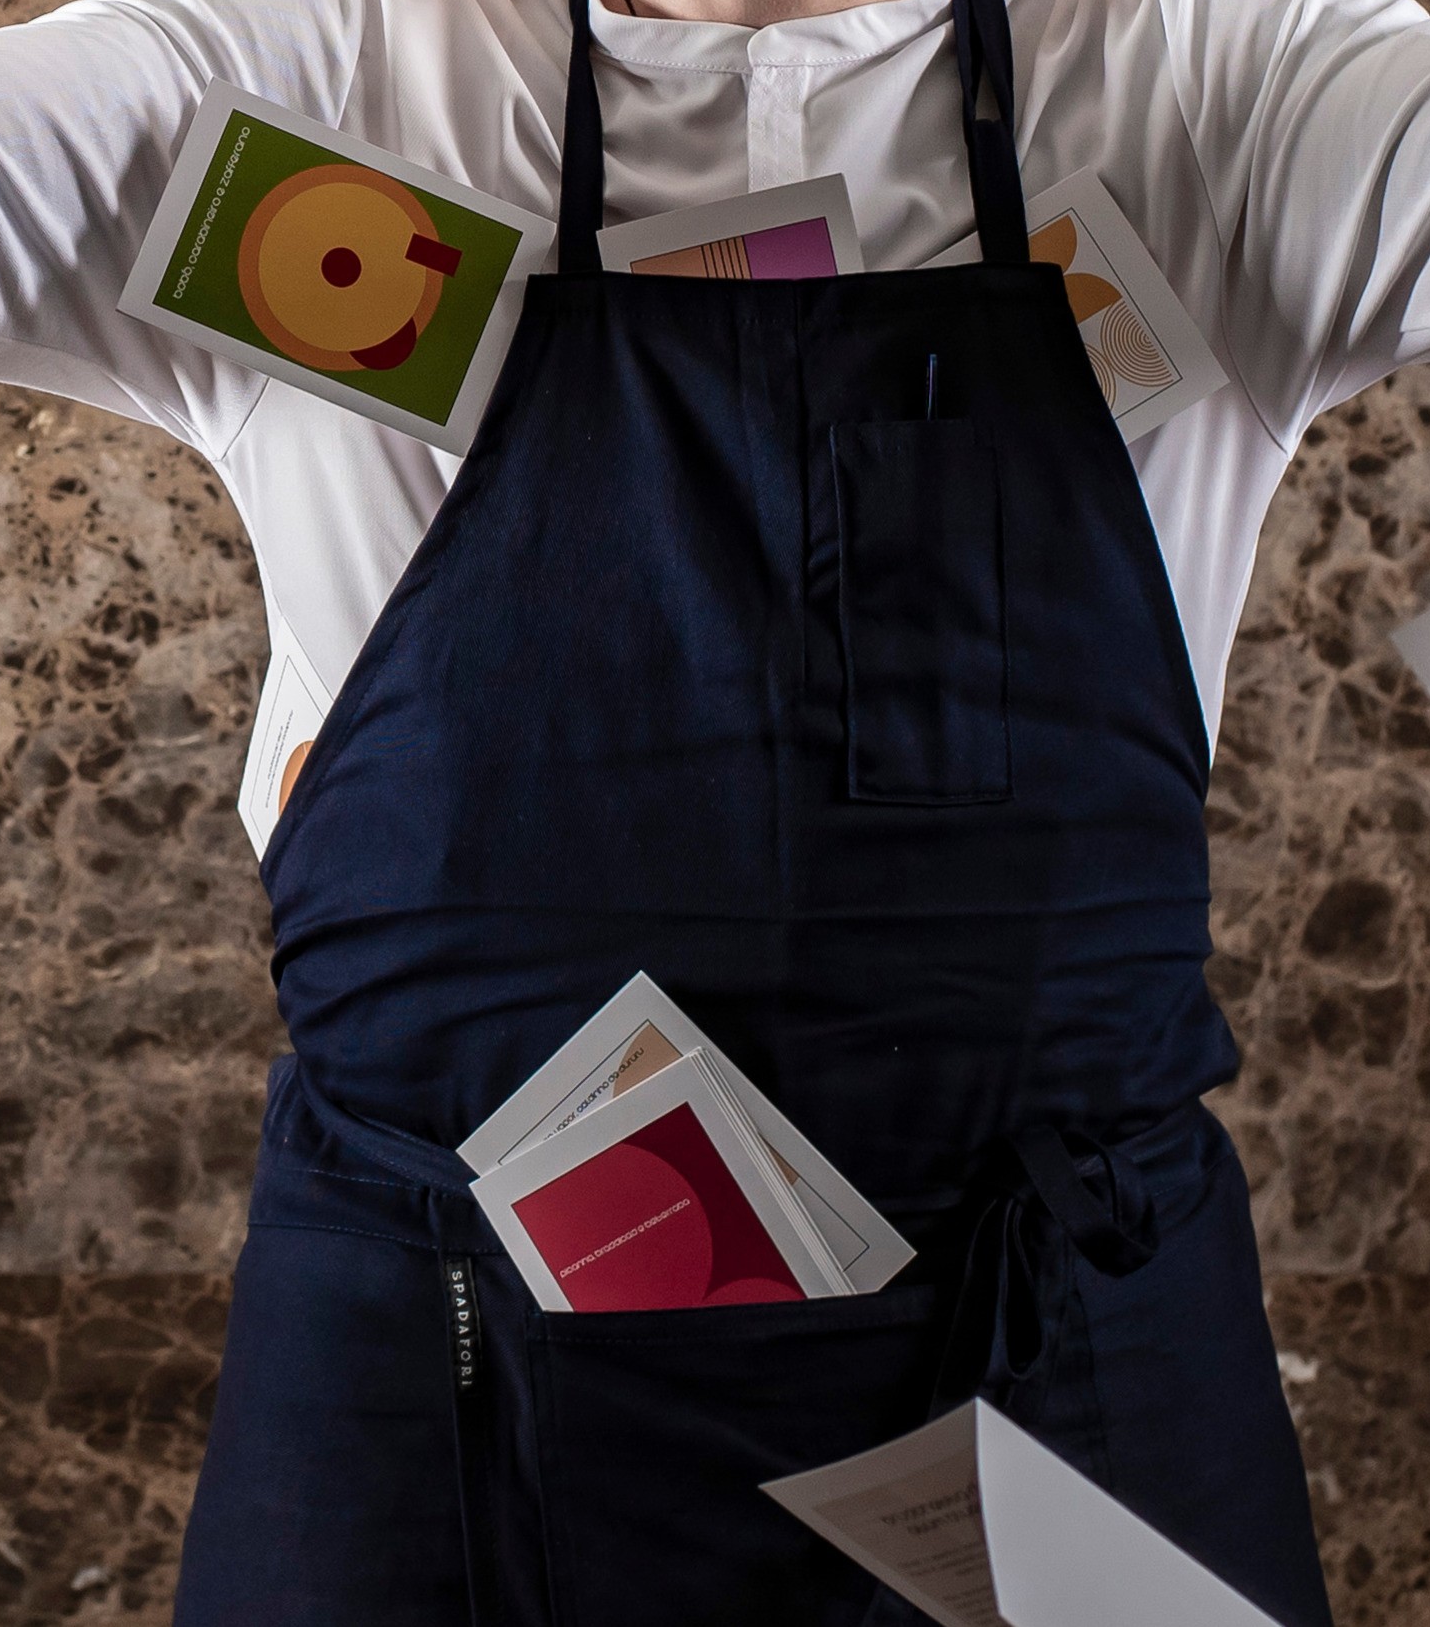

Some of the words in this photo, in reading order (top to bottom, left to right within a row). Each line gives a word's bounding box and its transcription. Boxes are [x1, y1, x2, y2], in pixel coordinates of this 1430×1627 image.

[220, 126, 251, 186] zafferano
[216, 186, 226, 196] e
[188, 196, 221, 264] carabineiro
[576, 1080, 608, 1114] caldinho
[451, 1270, 472, 1385] SPADAFORI
